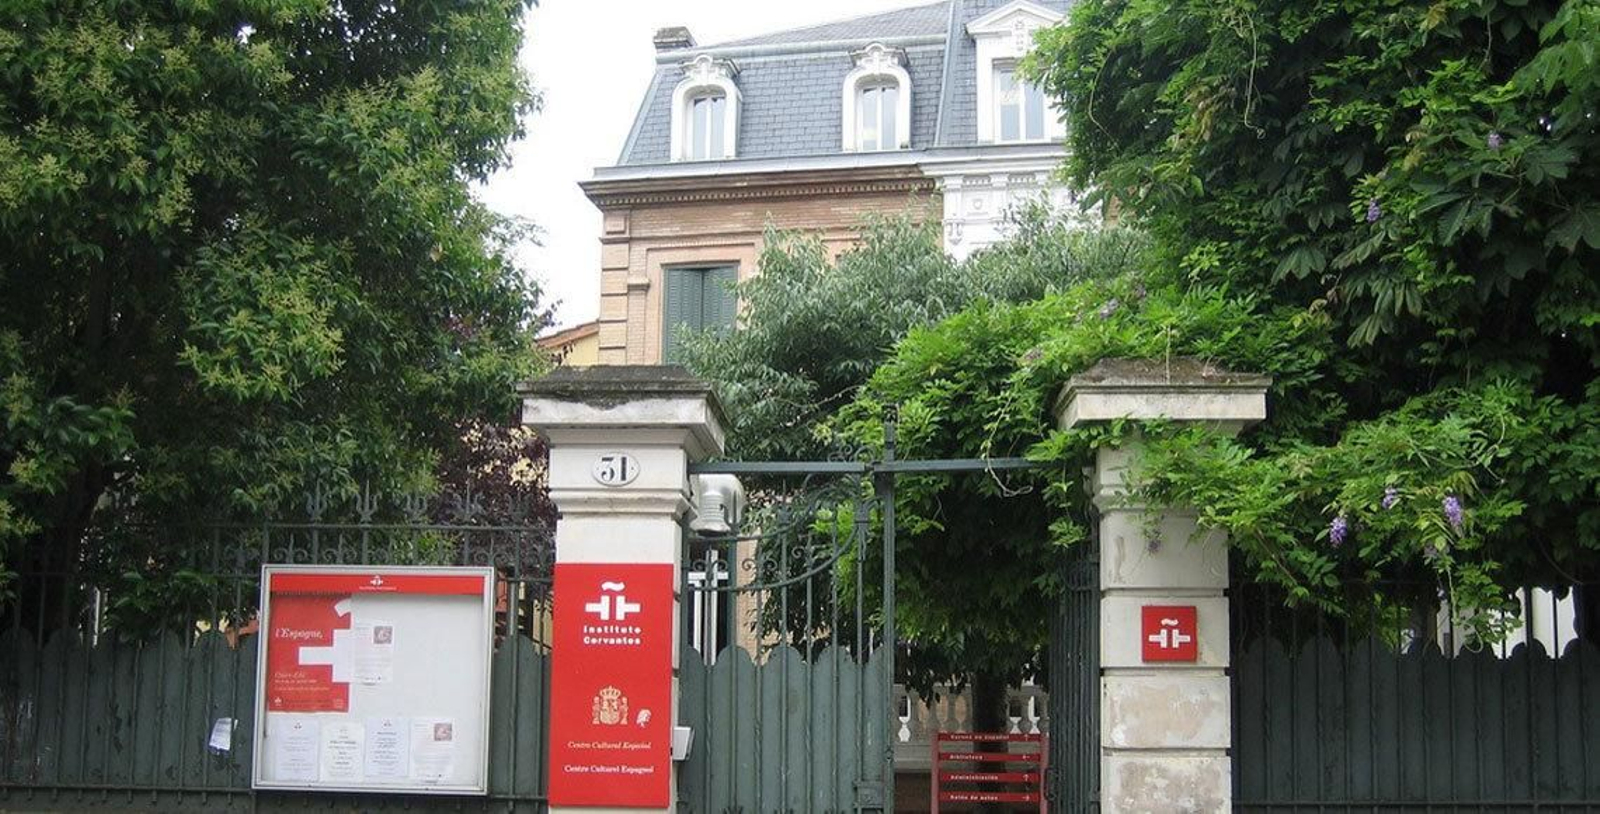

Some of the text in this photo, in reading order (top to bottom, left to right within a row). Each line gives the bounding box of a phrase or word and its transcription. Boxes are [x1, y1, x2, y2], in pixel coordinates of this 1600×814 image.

[601, 456, 627, 481] 31
[583, 625, 641, 634] Instituto
[583, 636, 640, 645] Cervantes
[567, 741, 652, 750] Centro Cultural Español
[564, 764, 654, 775] Centre Culturel Espagnol
